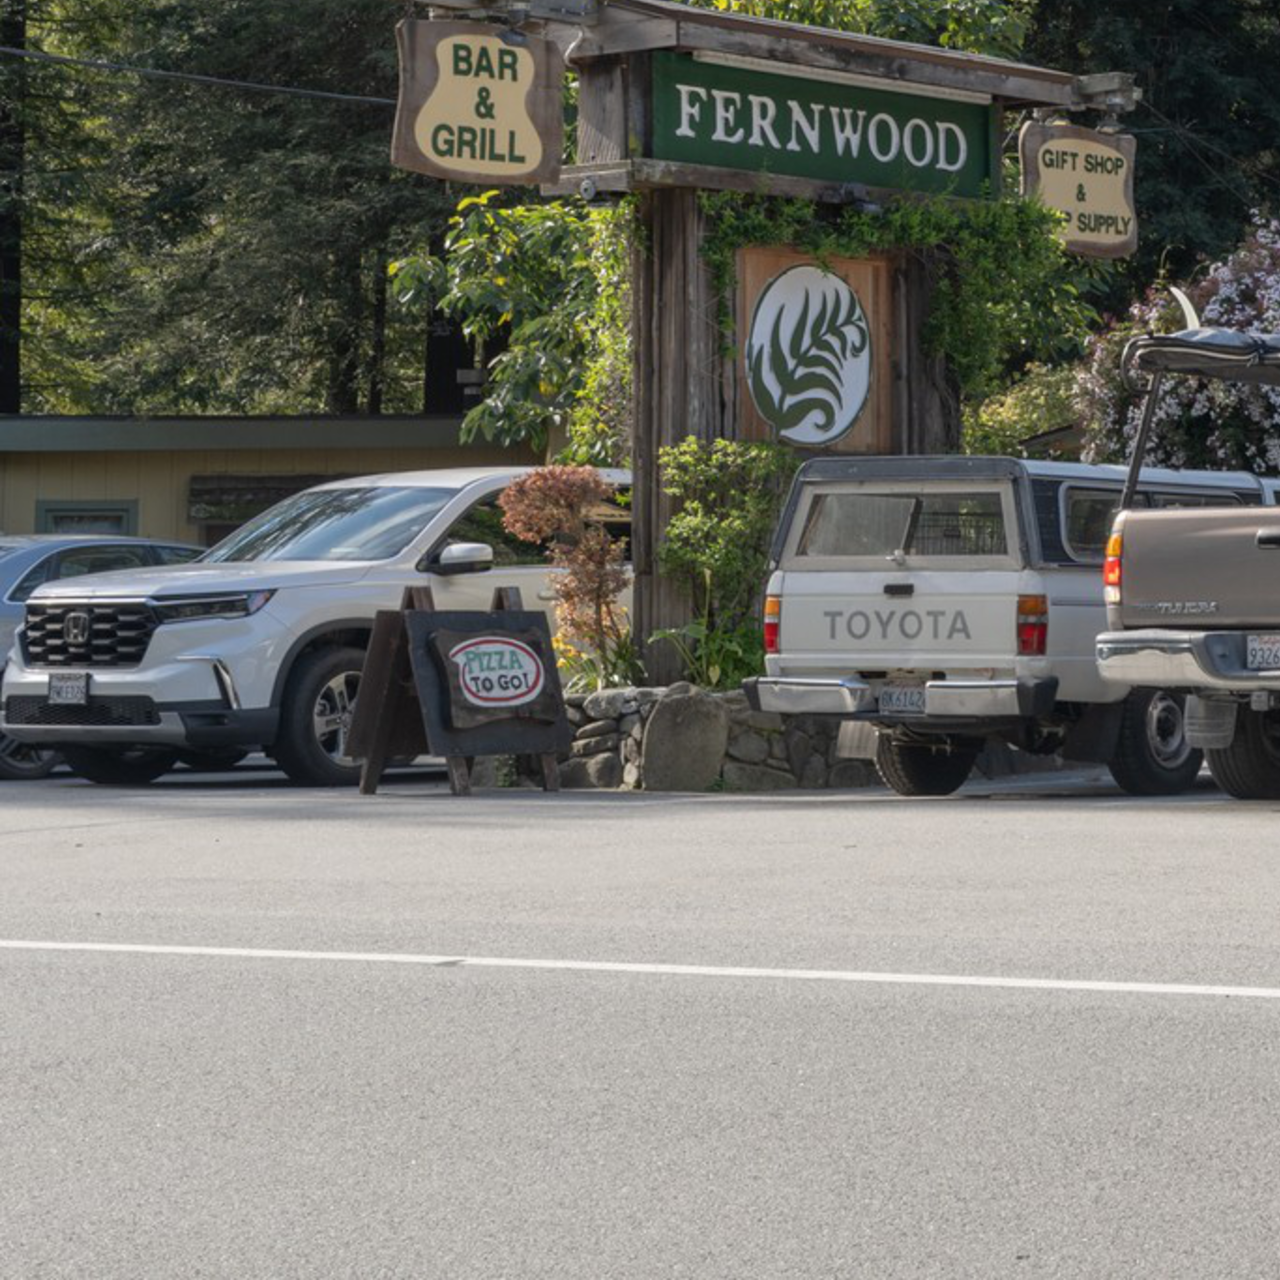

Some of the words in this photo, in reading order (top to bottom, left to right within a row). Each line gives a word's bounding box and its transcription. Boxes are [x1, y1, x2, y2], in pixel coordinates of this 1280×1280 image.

[452, 43, 518, 82] BAR
[474, 86, 495, 120] &
[675, 83, 968, 171] FERNWOOD
[431, 123, 526, 164] GRILL
[1042, 149, 1079, 172] GIFT
[1084, 153, 1124, 176] SHOP
[1076, 183, 1087, 202] &
[1077, 212, 1132, 236] SUPPLY
[823, 610, 972, 640] TOYOTA
[470, 676, 494, 692] TO
